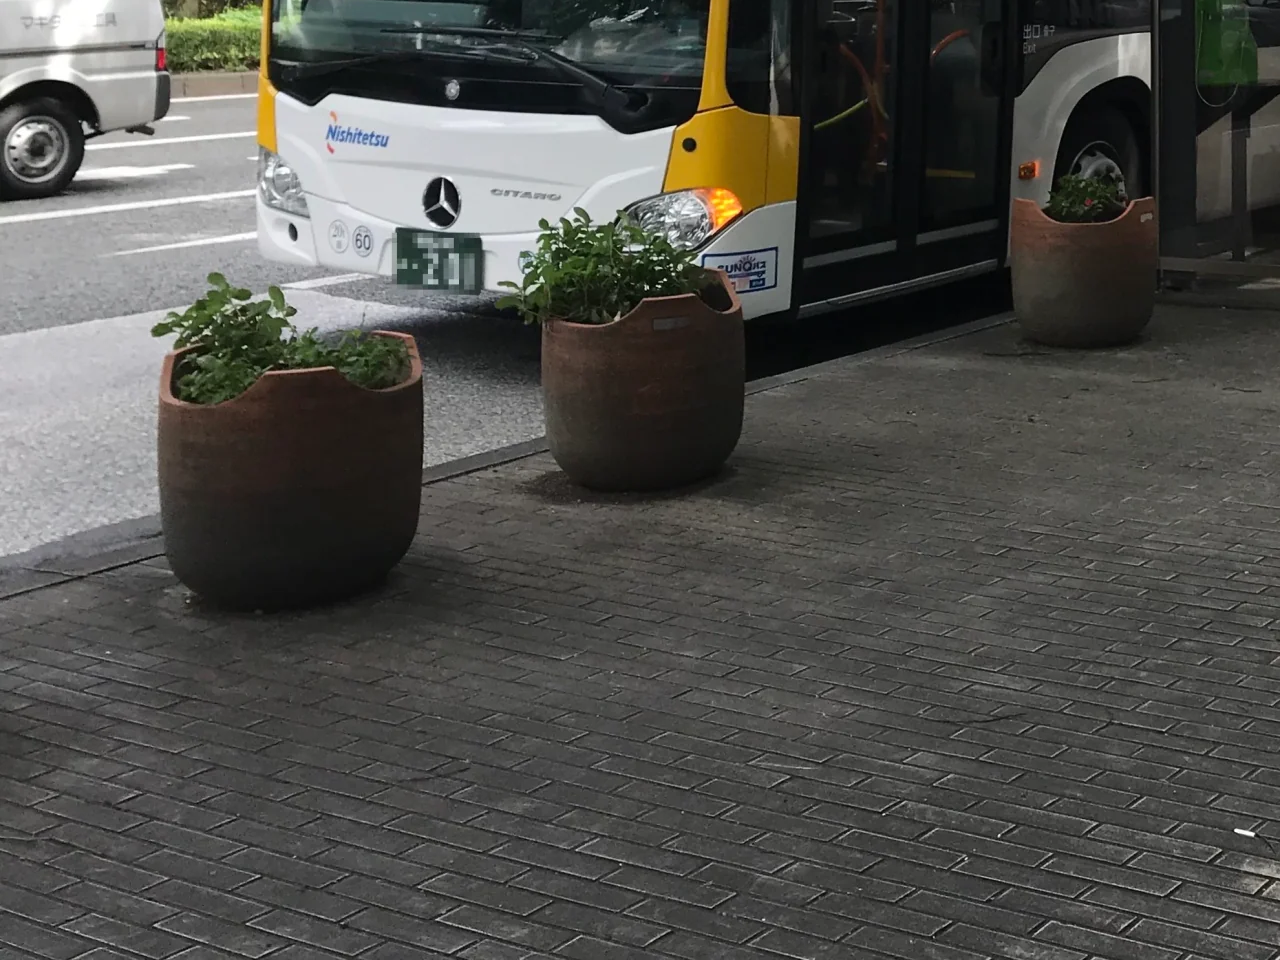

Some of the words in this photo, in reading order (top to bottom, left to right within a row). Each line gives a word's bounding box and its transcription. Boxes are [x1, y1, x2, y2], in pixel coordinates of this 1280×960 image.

[1023, 24, 1041, 39] 出口
[325, 124, 390, 148] Nishitetsu
[490, 188, 562, 201] CITARO
[355, 233, 372, 251] 60
